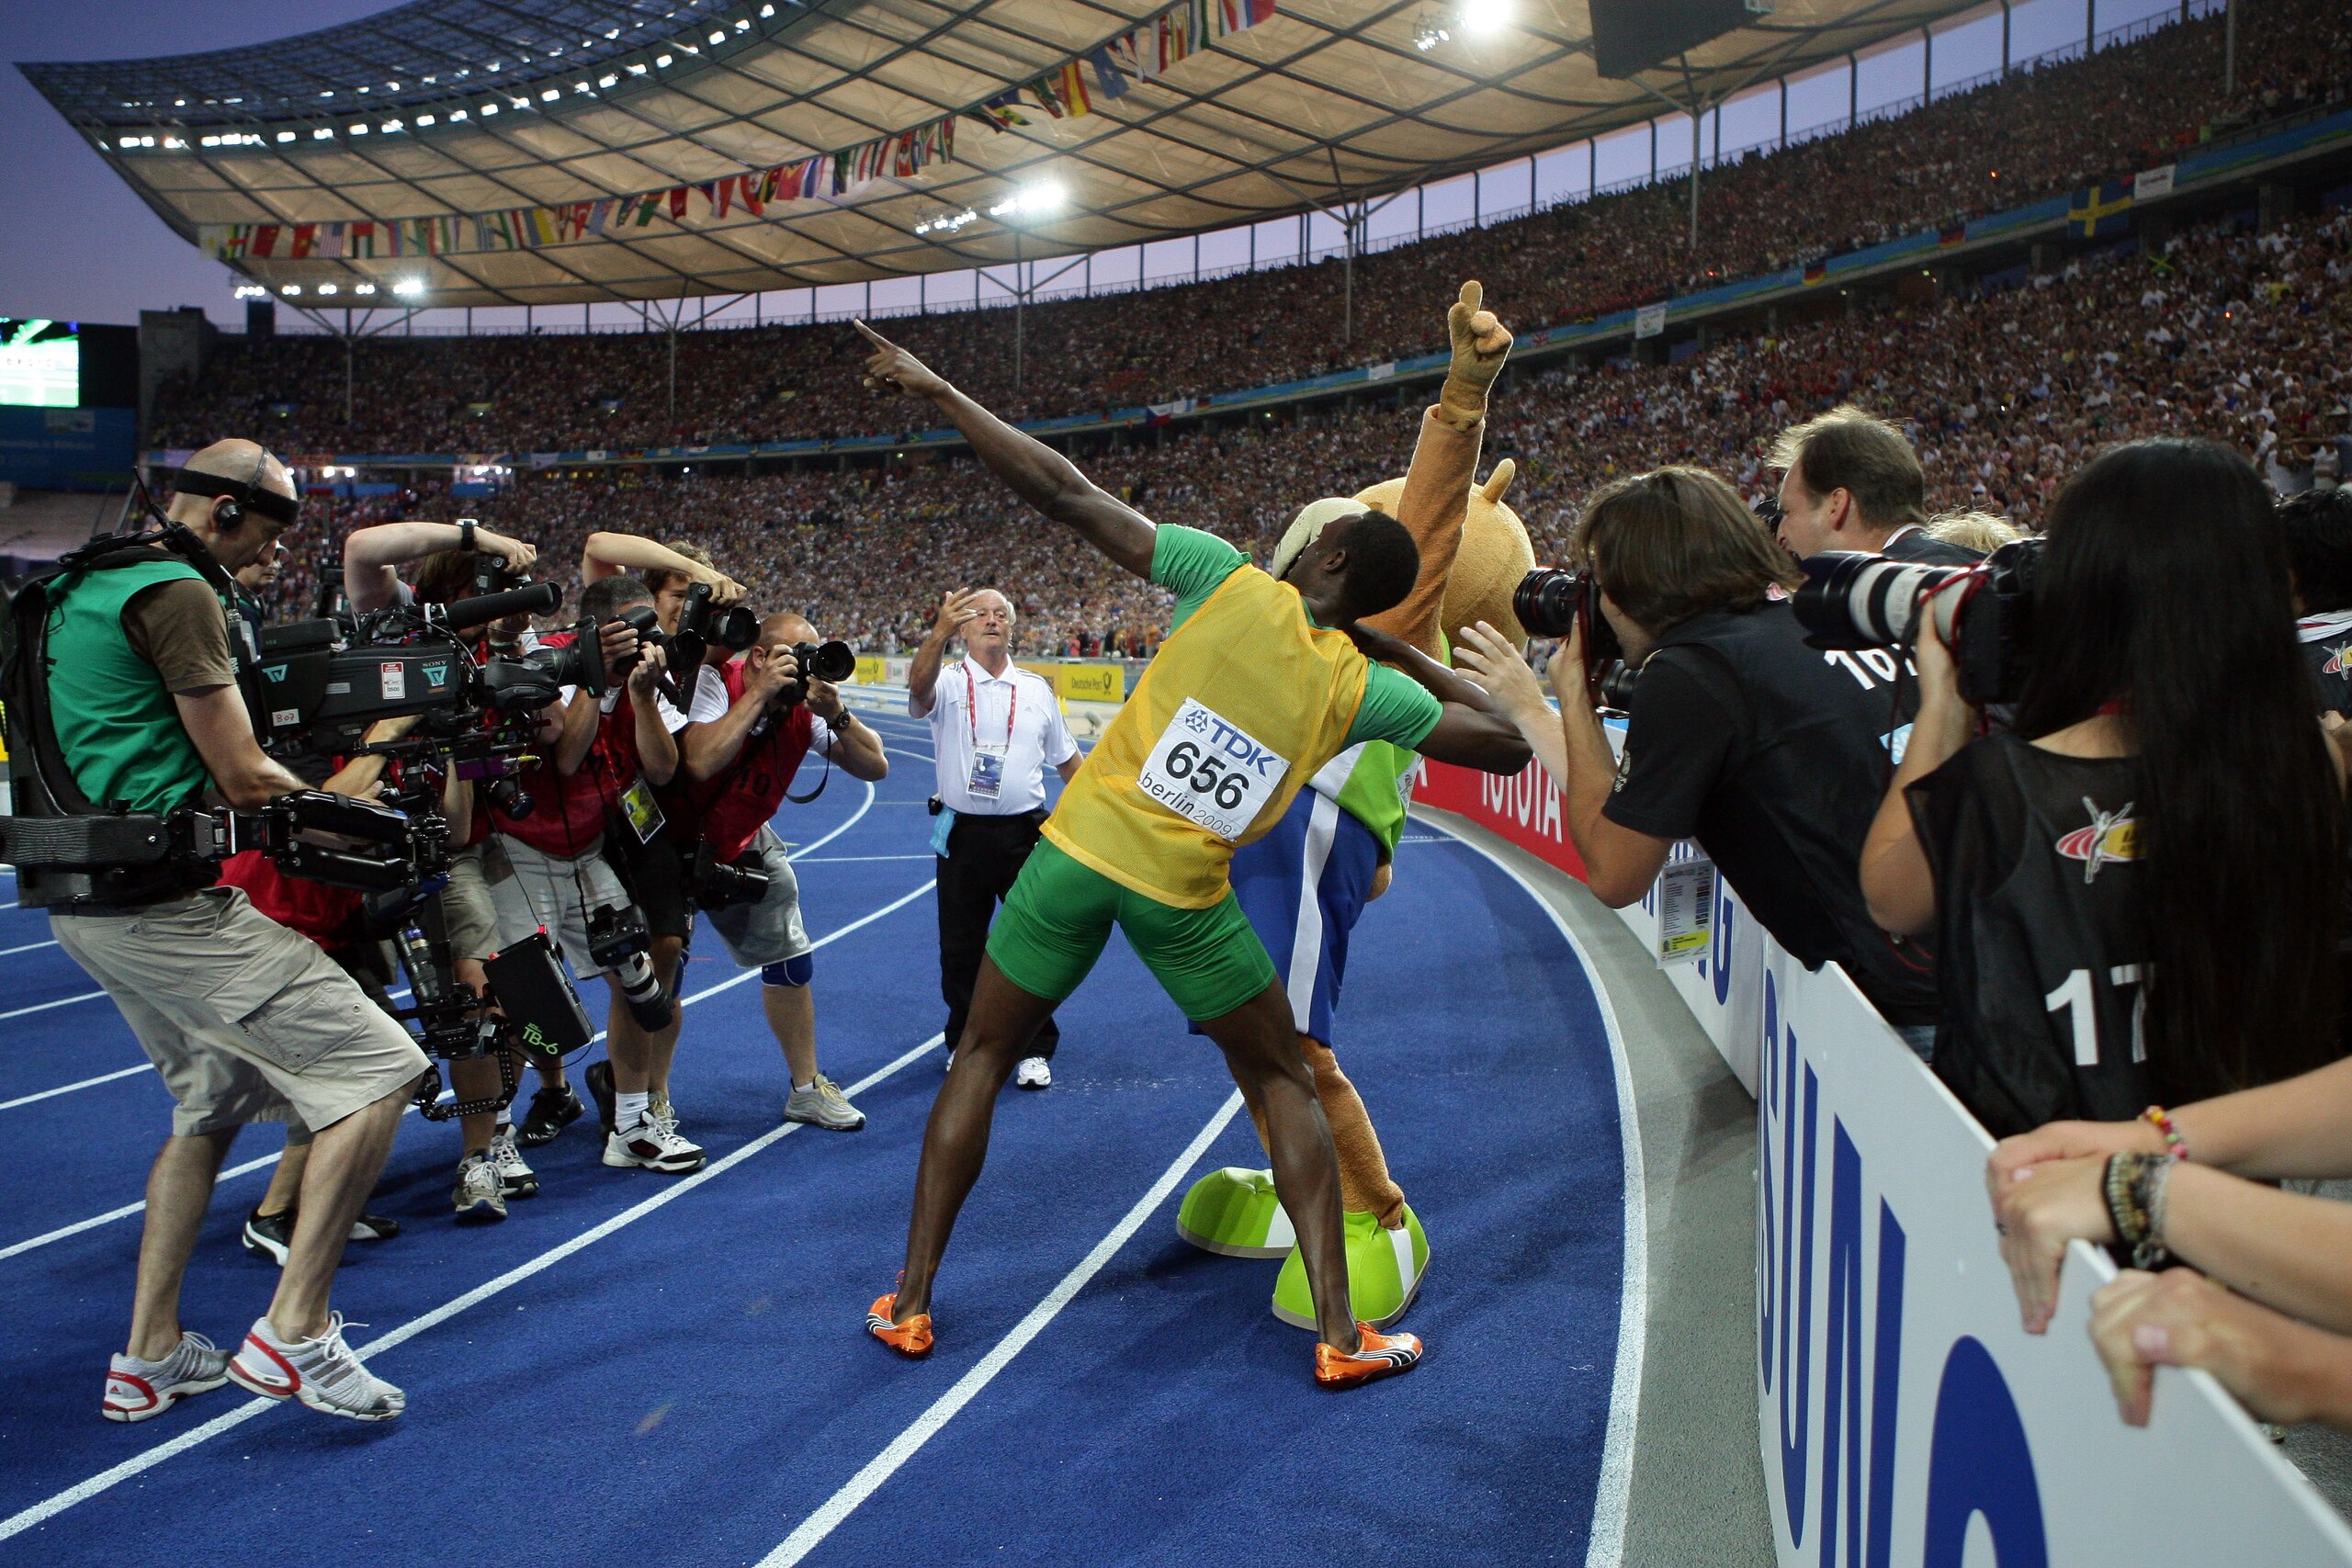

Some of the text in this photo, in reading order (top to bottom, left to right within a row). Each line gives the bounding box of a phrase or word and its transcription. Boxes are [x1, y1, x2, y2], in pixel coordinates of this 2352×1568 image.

[422, 660, 447, 668] SONY
[1071, 676, 1092, 690] Deutsche
[1209, 716, 1277, 777] TDK
[1164, 740, 1250, 810] 656
[1140, 772, 1232, 837] berlin 2009
[522, 1026, 560, 1055] TB-6
